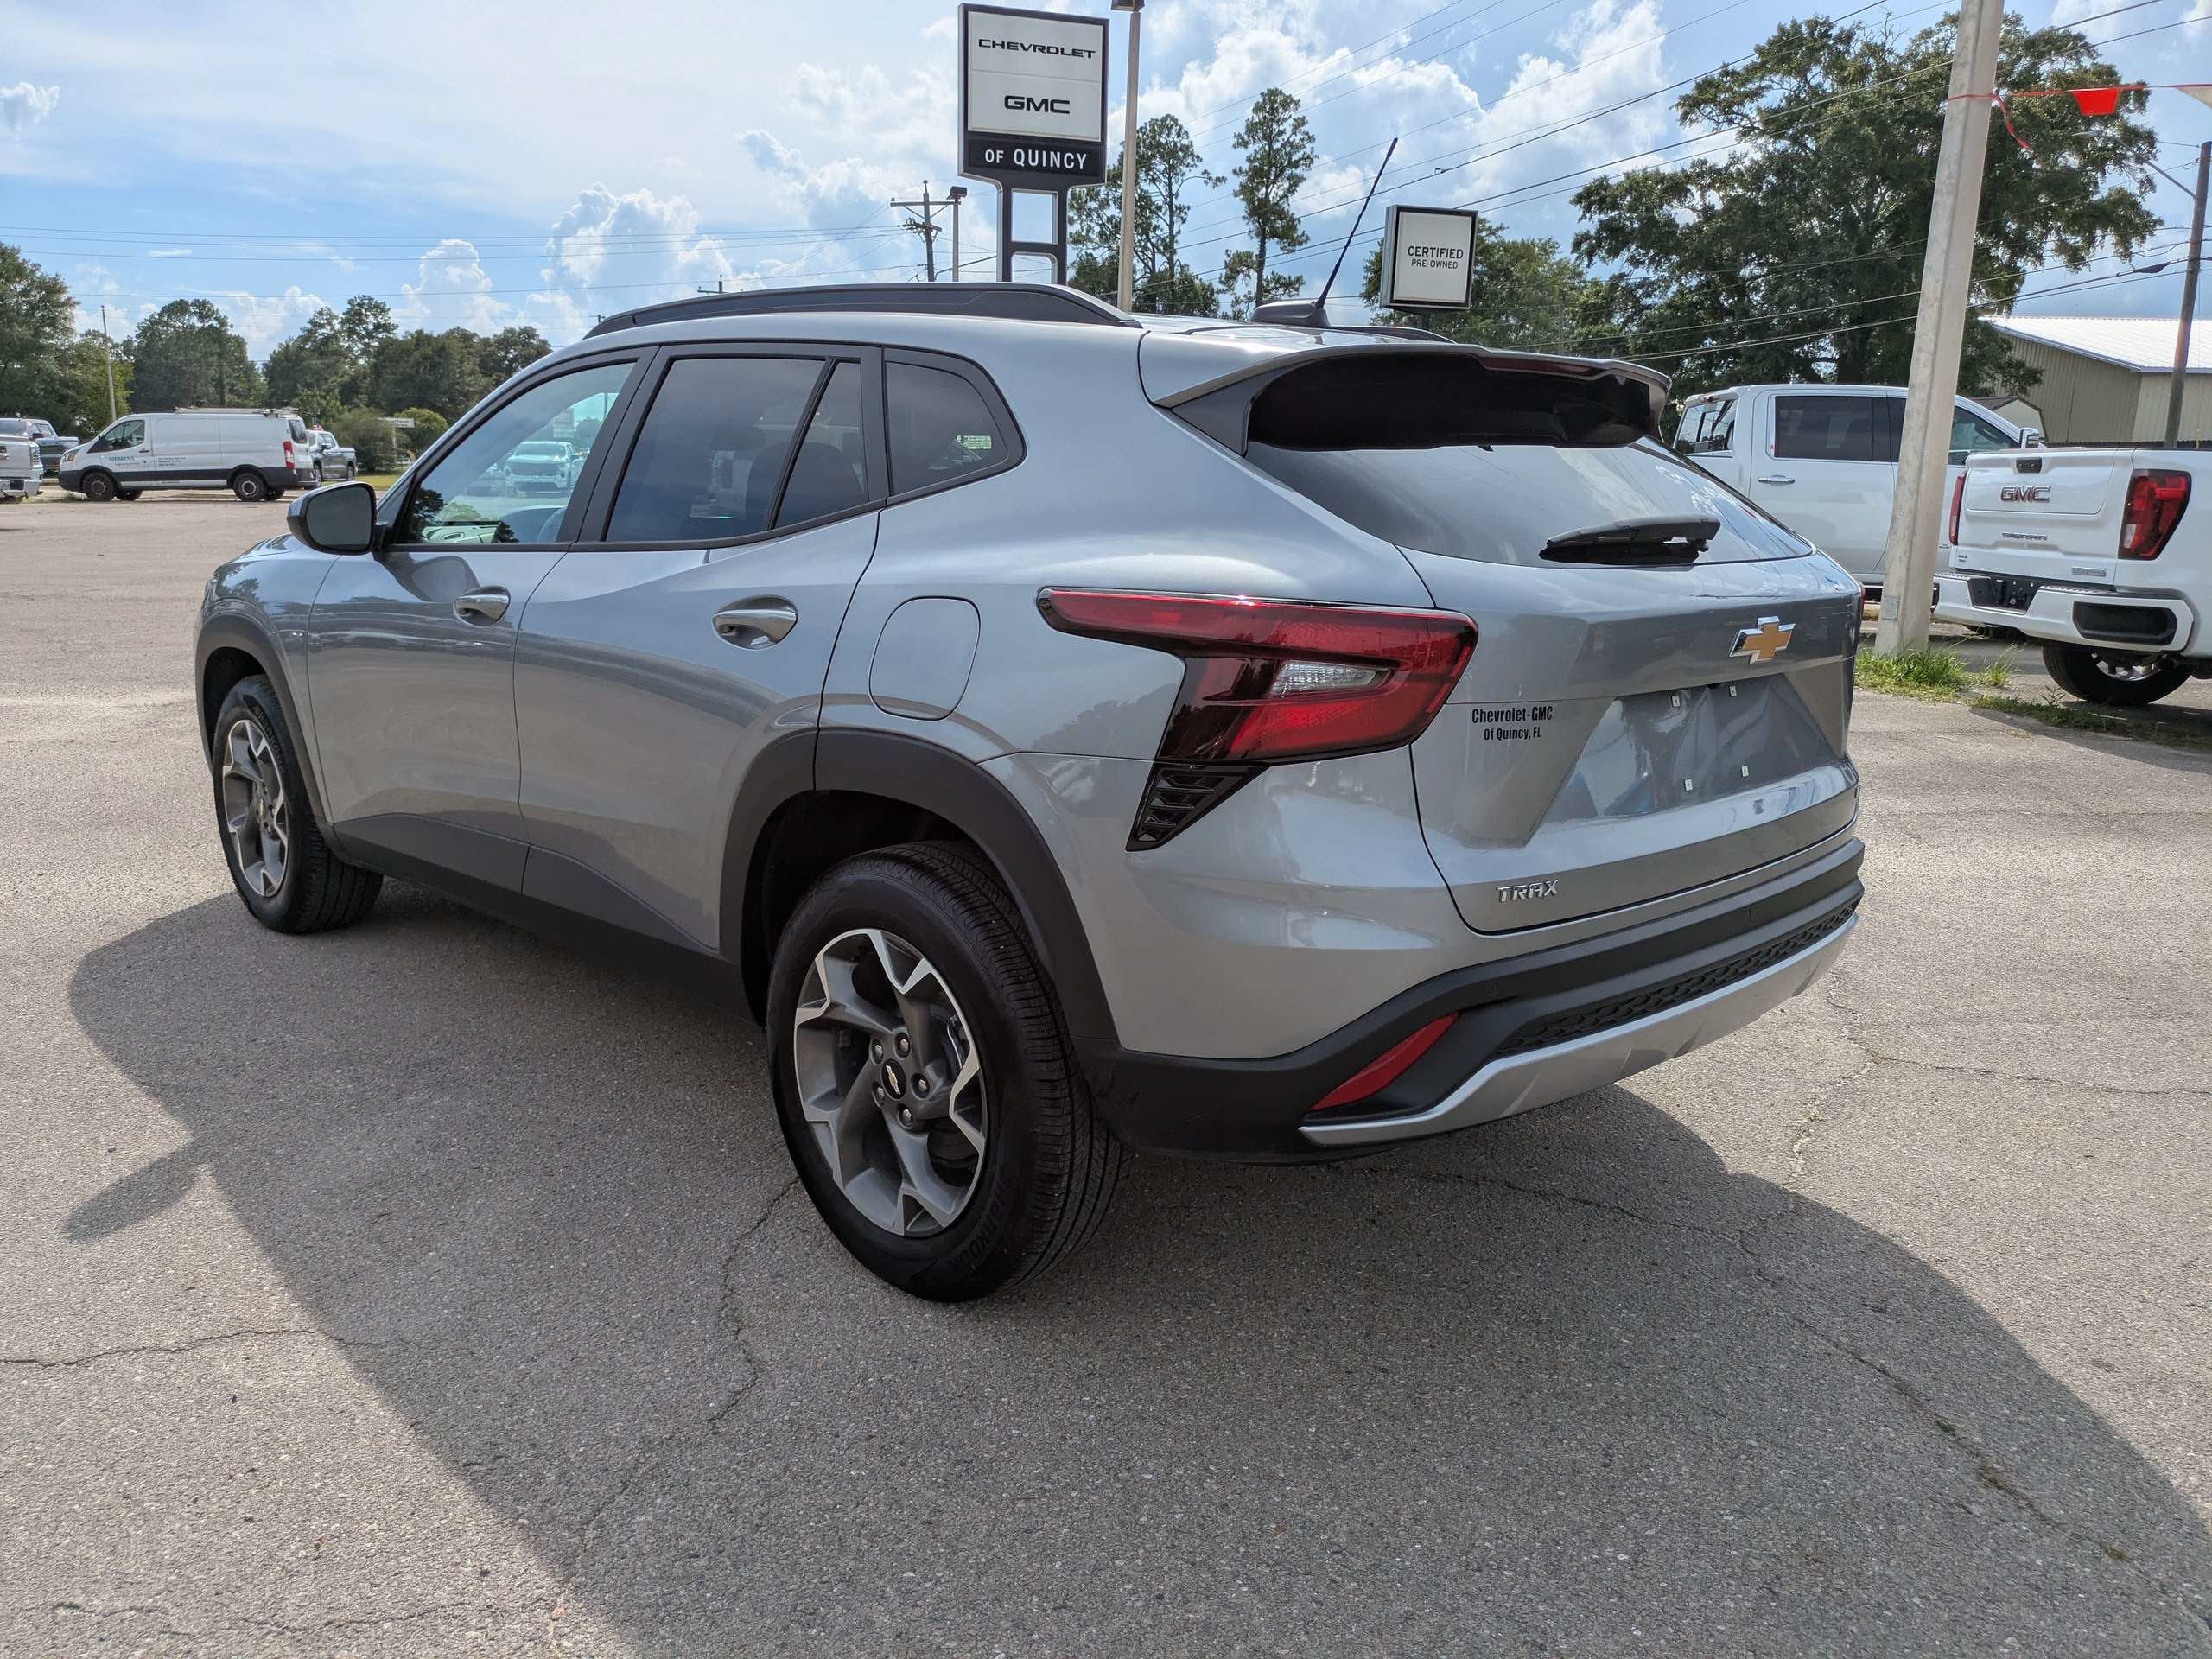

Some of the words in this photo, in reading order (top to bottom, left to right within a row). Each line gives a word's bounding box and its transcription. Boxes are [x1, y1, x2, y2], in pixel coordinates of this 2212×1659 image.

[978, 39, 1096, 59] CHEVROLET
[1003, 95, 1071, 114] GMC
[984, 149, 1004, 163] OF
[1013, 148, 1087, 169] QUINCY
[1408, 245, 1464, 259] CERTIFIED
[1411, 258, 1459, 270] PRE-OWNED
[2000, 485, 2052, 503] GMC
[1471, 705, 1554, 723] Chevrolet-GMC
[1484, 728, 1494, 741] Of
[1496, 726, 1531, 741] Quincy,
[1496, 879, 1559, 903] TRAX
